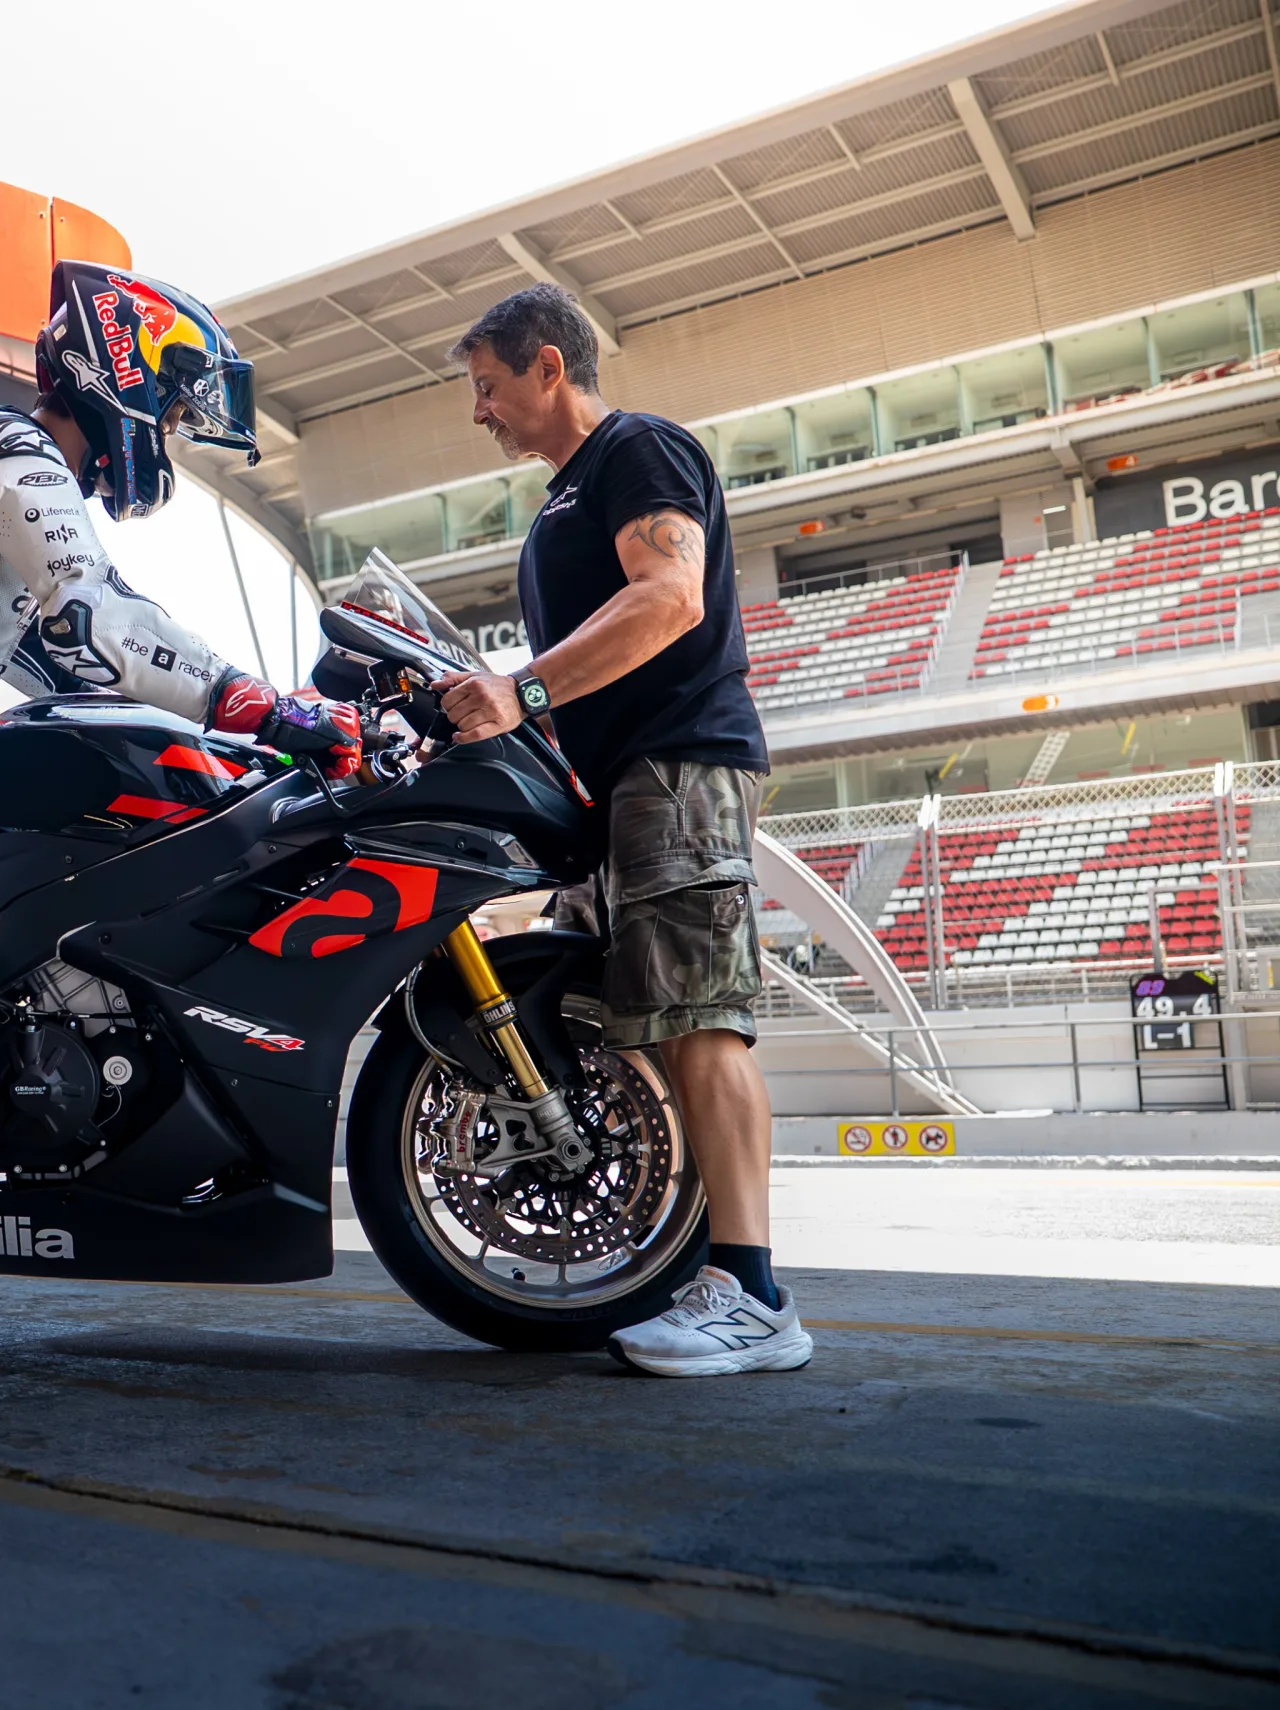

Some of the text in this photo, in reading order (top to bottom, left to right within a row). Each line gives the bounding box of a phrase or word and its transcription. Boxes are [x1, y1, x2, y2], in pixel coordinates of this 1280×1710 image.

[1162, 471, 1280, 528] Bar
[46, 554, 95, 577] joykey
[121, 636, 149, 657] #be
[178, 660, 216, 683] racer
[483, 1000, 517, 1024] ÖHLINS
